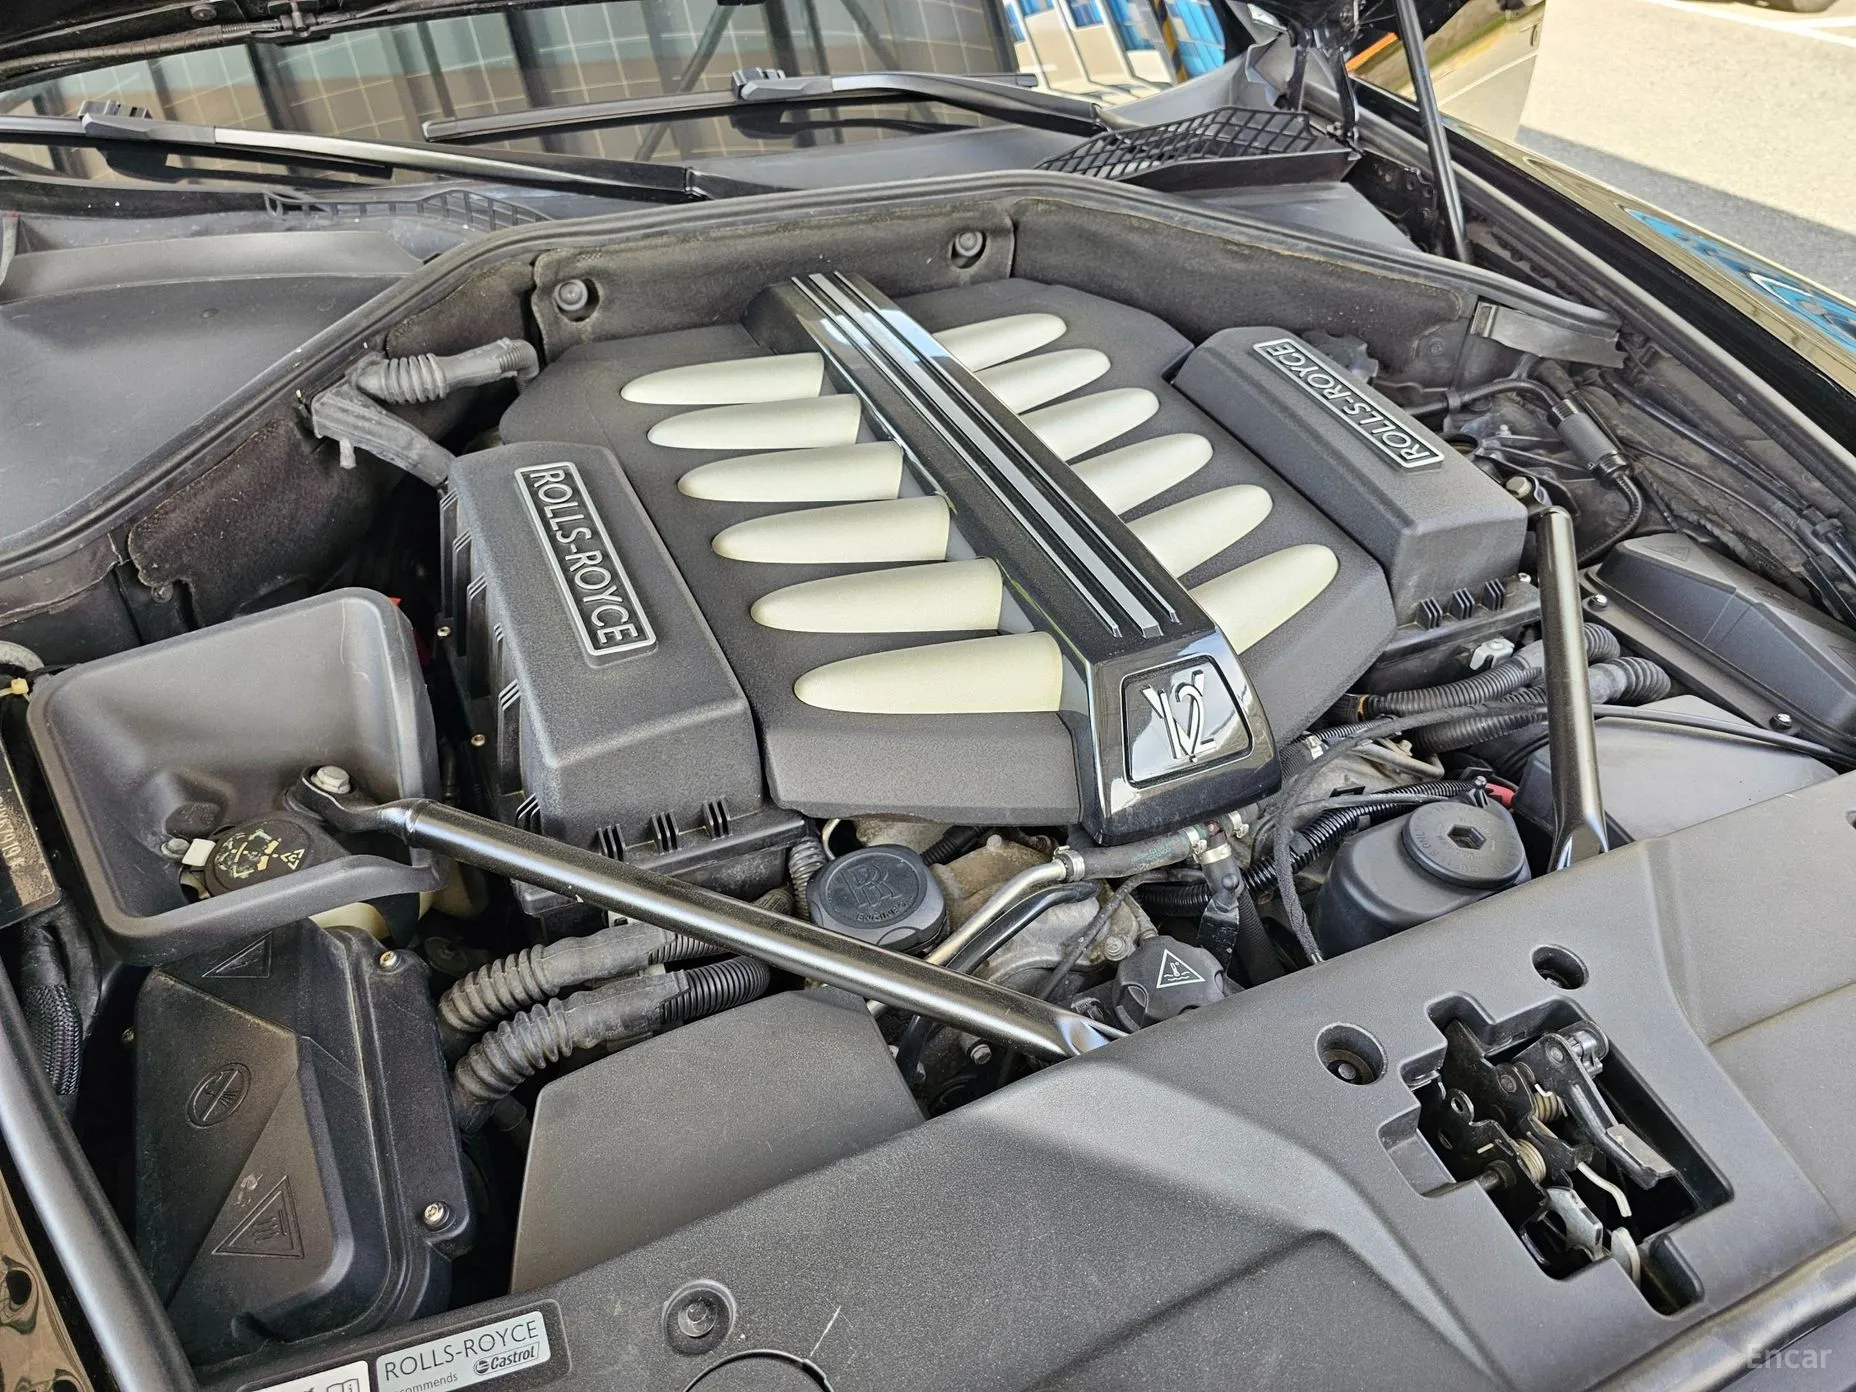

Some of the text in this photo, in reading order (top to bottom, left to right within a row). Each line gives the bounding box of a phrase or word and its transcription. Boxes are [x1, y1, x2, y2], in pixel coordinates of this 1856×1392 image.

[1266, 343, 1431, 461] ROLLS-ROYCE
[529, 469, 639, 645] ROLLS-ROYCE
[384, 1320, 539, 1381] ROLLS-ROYCE
[491, 1345, 535, 1370] Castrol
